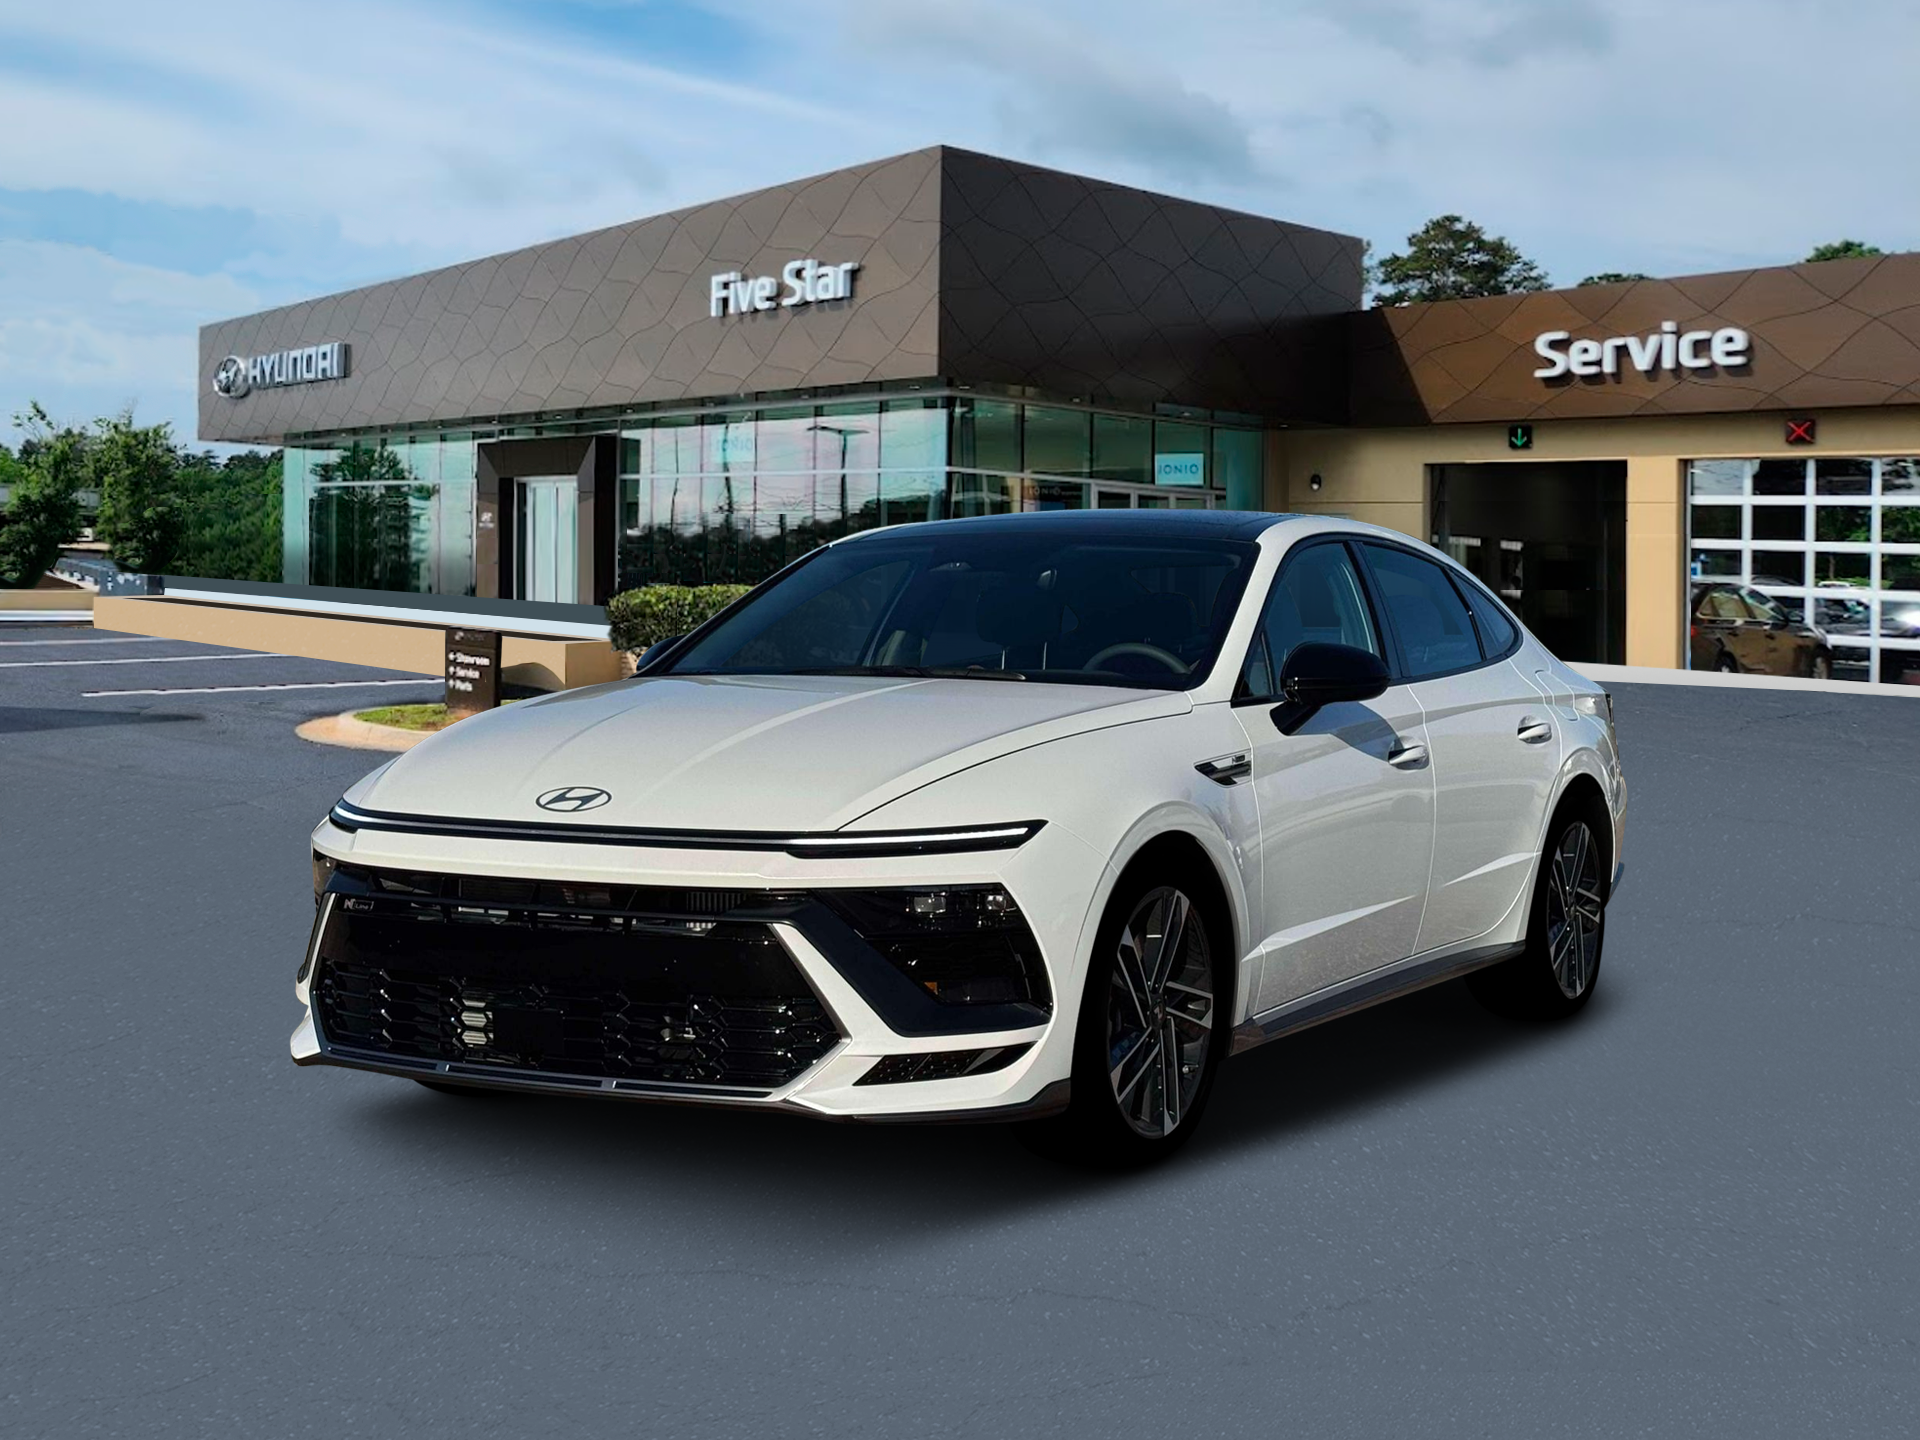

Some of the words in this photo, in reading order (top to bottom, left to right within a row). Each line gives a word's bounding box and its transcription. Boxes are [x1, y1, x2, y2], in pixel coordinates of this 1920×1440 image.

[710, 271, 777, 317] Five
[781, 259, 859, 306] Star
[248, 341, 344, 385] HYUNDAI
[1533, 320, 1749, 378] Service
